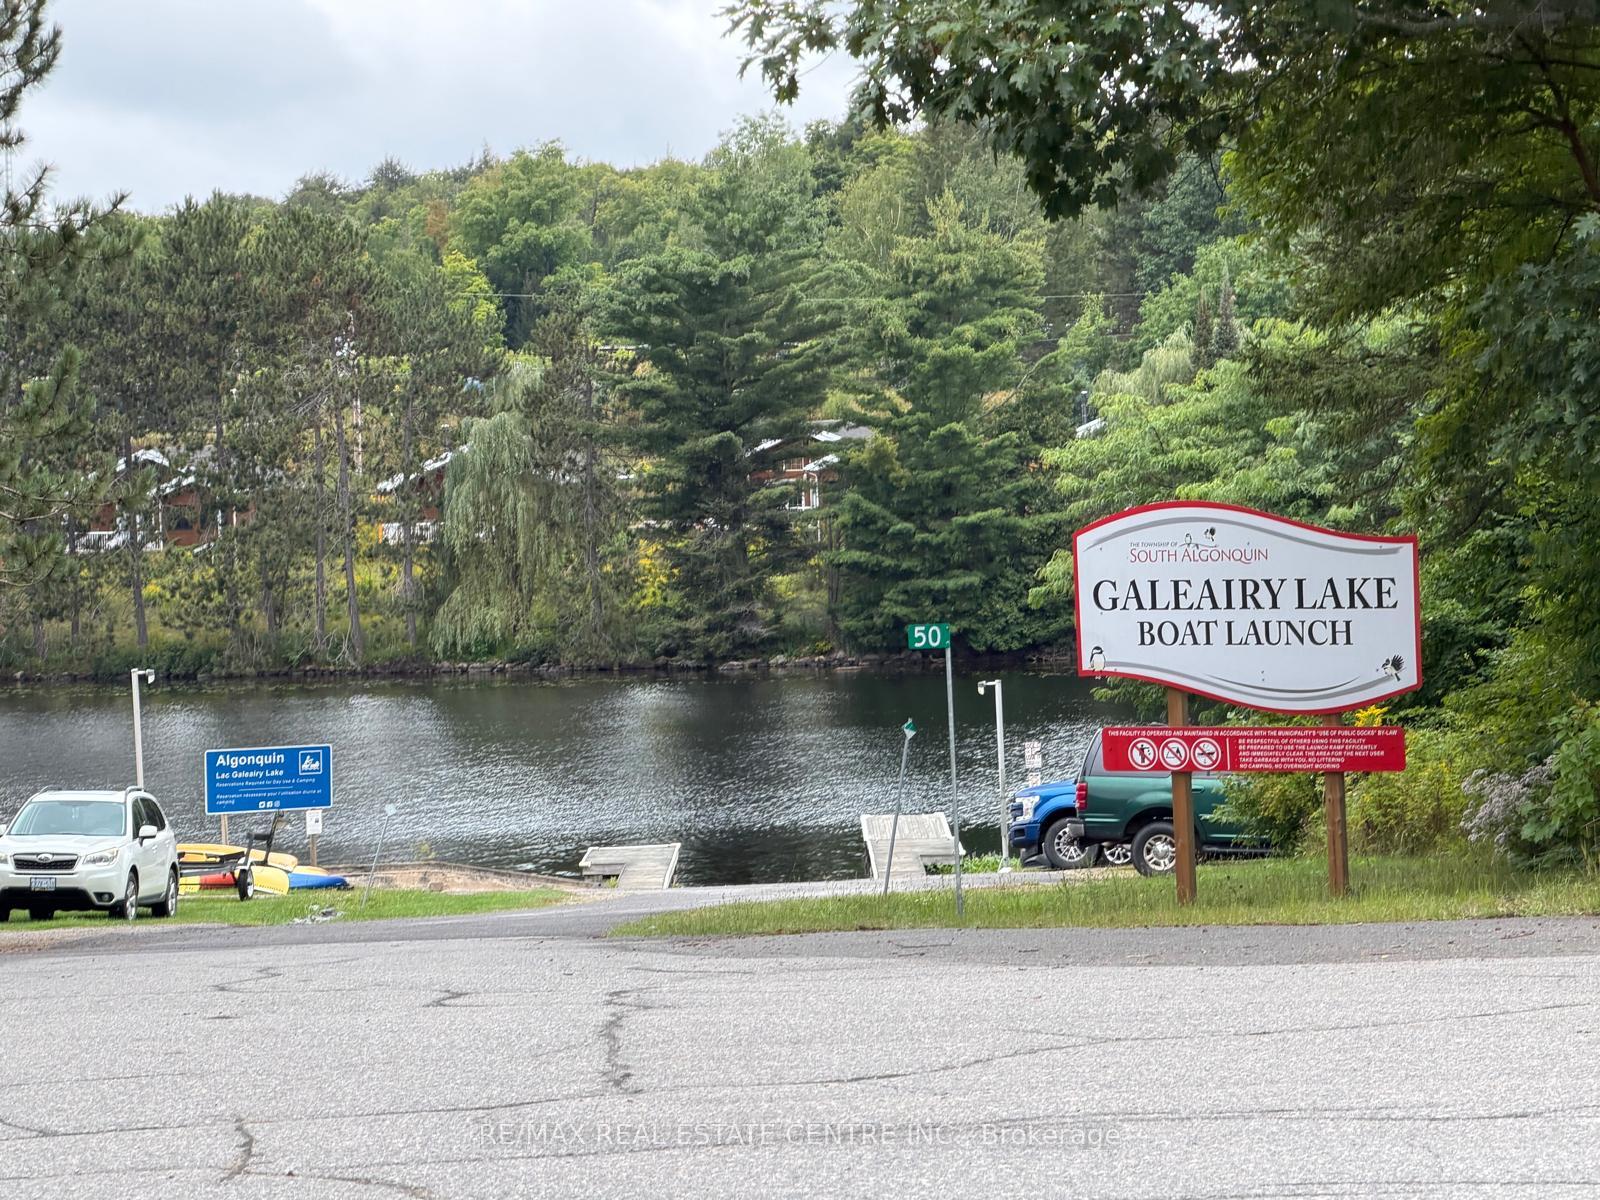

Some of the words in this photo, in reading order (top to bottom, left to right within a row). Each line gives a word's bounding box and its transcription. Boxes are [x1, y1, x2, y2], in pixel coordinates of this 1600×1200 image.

[1130, 548, 1177, 564] SOUTH
[1182, 548, 1268, 564] ALGONQUIN
[1092, 578, 1286, 612] GALEAIRY
[1294, 577, 1399, 610] LAKE
[914, 626, 941, 648] 50
[1137, 620, 1218, 646] BOAT
[1224, 620, 1354, 646] LAUNCH
[216, 752, 284, 768] Algonquin
[216, 772, 230, 780] Lac
[231, 770, 264, 778] Galeairy
